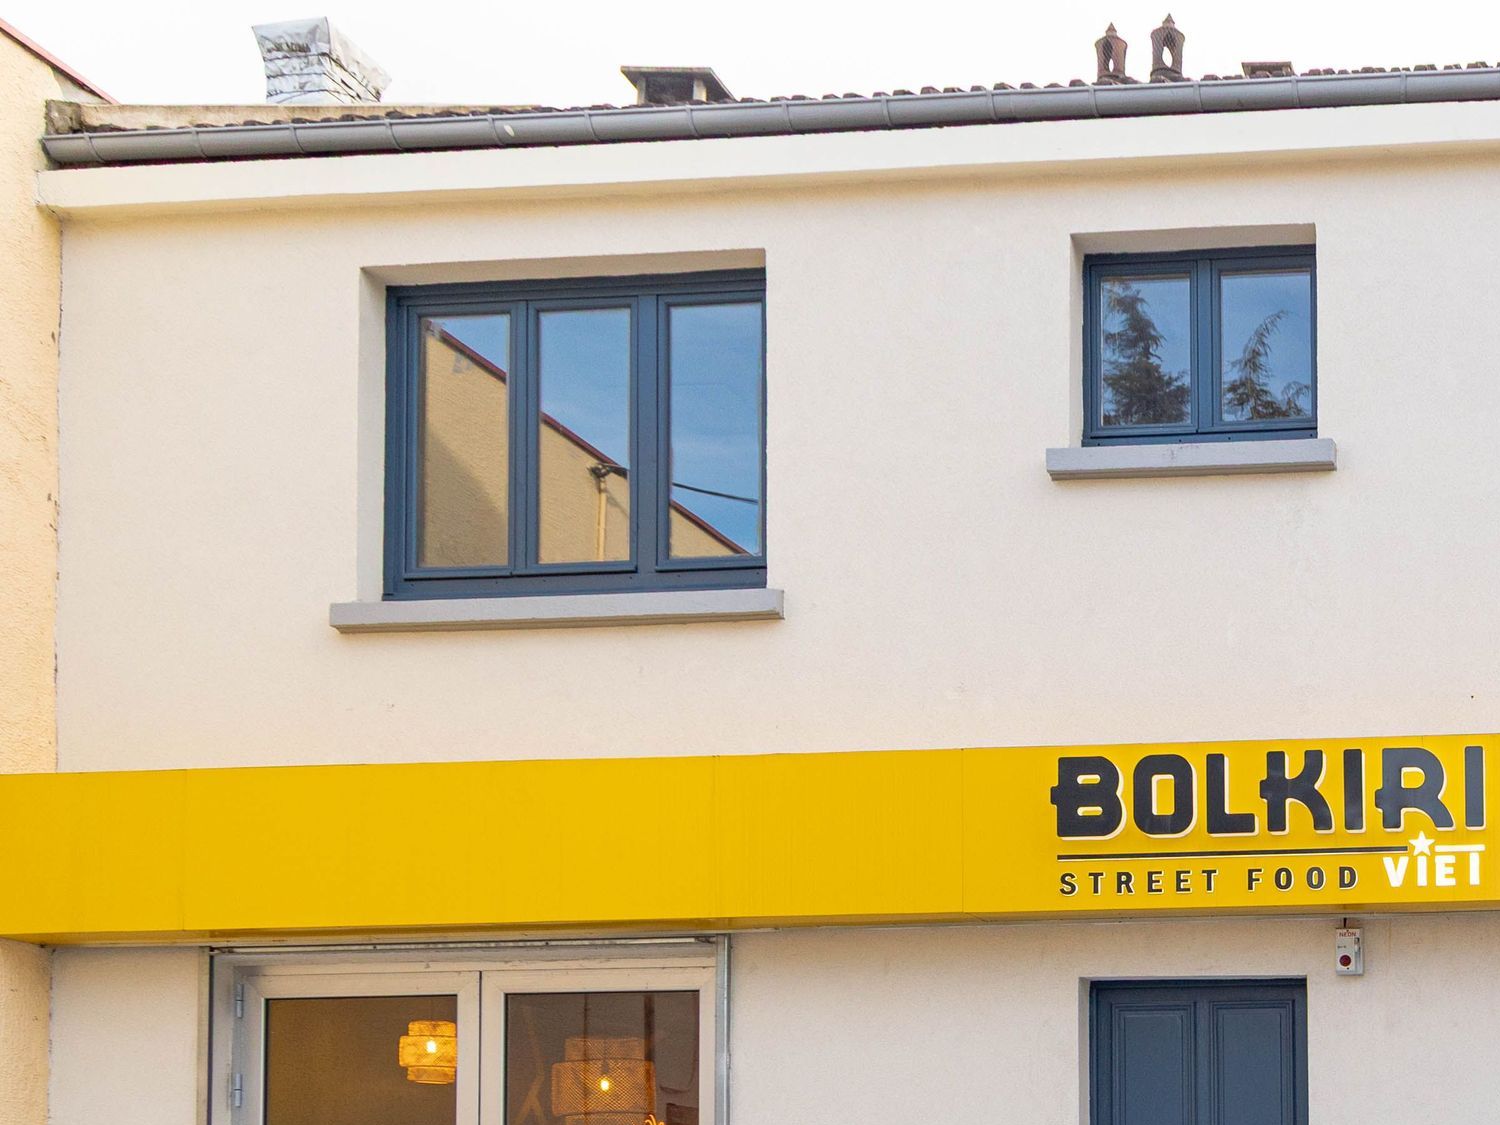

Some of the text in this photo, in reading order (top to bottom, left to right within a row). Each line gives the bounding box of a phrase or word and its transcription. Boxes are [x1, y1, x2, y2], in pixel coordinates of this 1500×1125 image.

[1051, 746, 1486, 840] BOLKIRI
[1059, 866, 1358, 896] STREET FOOD
[1382, 843, 1486, 887] VIET
